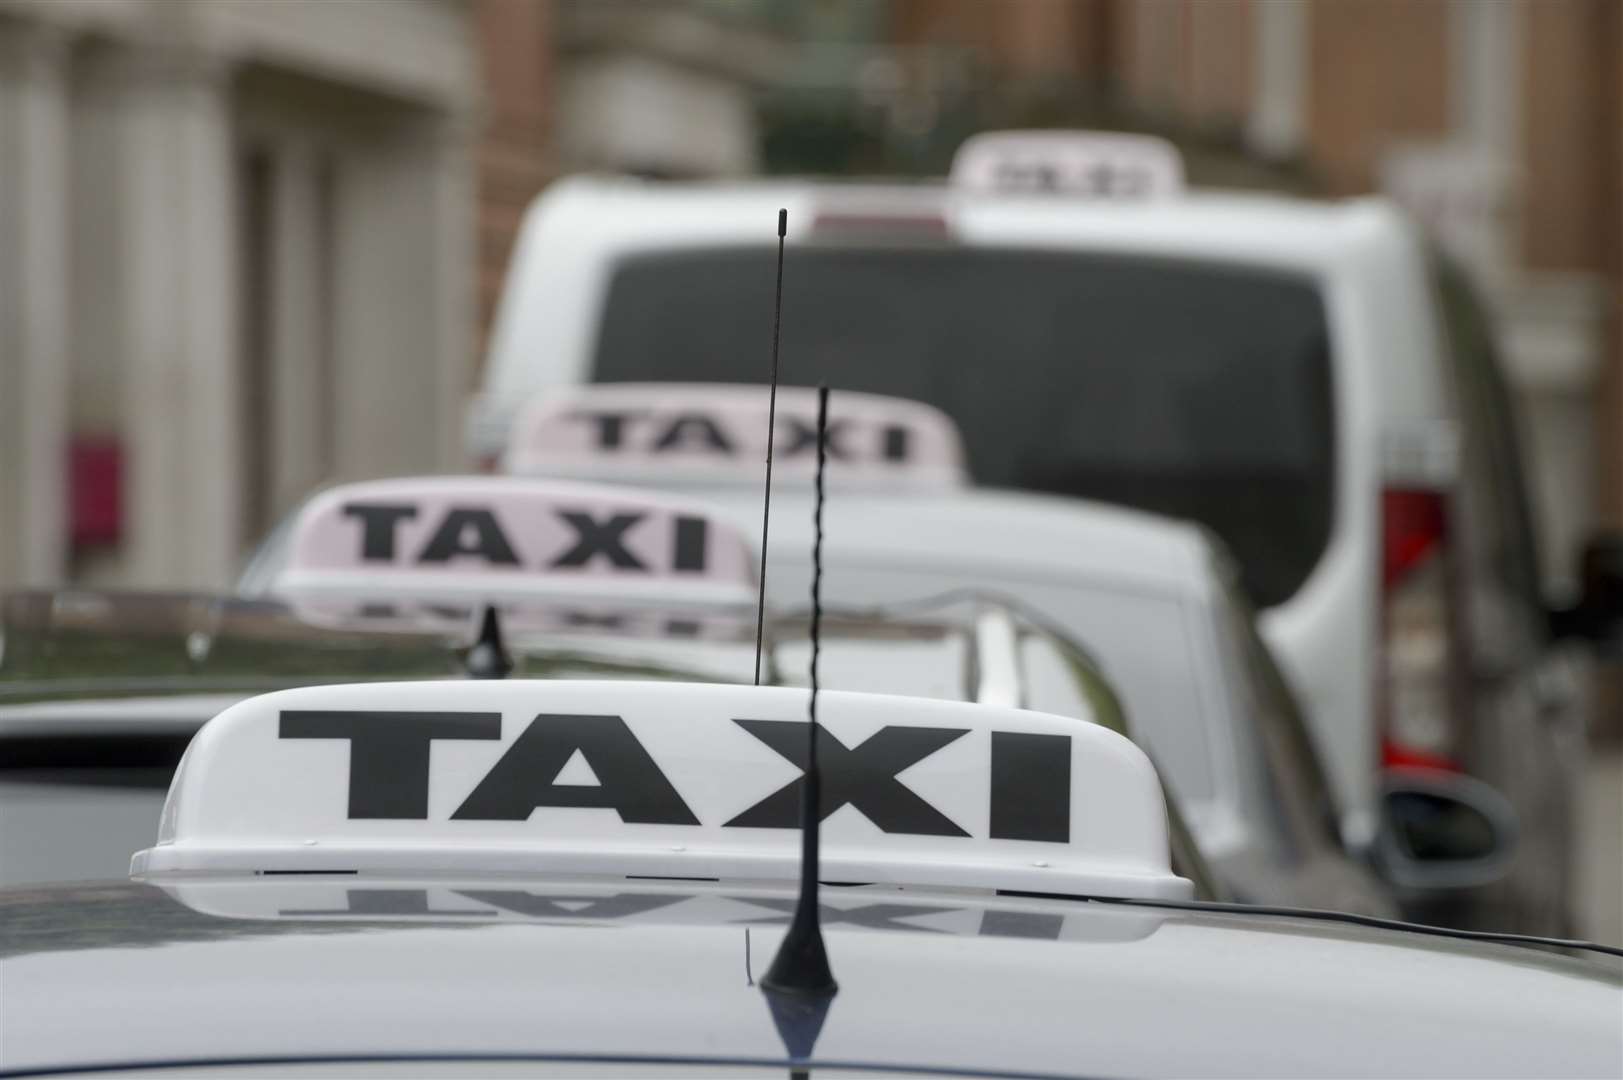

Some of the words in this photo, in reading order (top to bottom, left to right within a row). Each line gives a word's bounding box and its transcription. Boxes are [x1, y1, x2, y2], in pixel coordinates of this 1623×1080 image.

[563, 408, 914, 463] TAXI
[341, 503, 708, 573] TAXI
[279, 710, 1072, 843] TAXI
